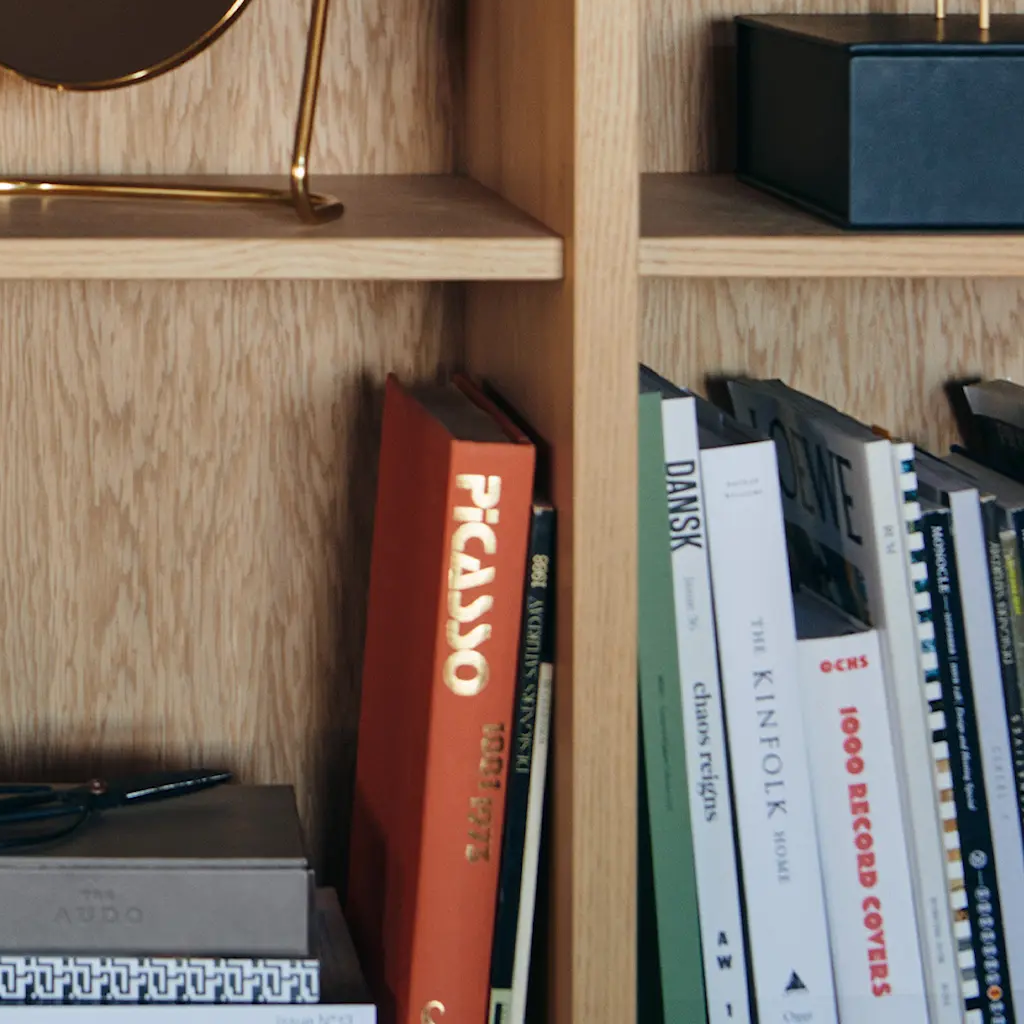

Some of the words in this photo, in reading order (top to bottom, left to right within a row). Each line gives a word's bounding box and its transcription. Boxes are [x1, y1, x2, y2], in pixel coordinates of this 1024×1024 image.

[665, 459, 704, 553] DANSK
[929, 525, 952, 595] MONOCLE
[524, 594, 545, 678] SATURDAY
[750, 615, 768, 656] THE
[692, 681, 714, 746] chaos
[751, 668, 789, 821] KINFOLK
[839, 705, 866, 776] 1000
[696, 752, 719, 823] reigns
[772, 830, 791, 885] HOME
[847, 782, 880, 889] RECORD
[716, 954, 733, 971] W
[717, 930, 729, 946] A
[861, 894, 893, 998] COVERS
